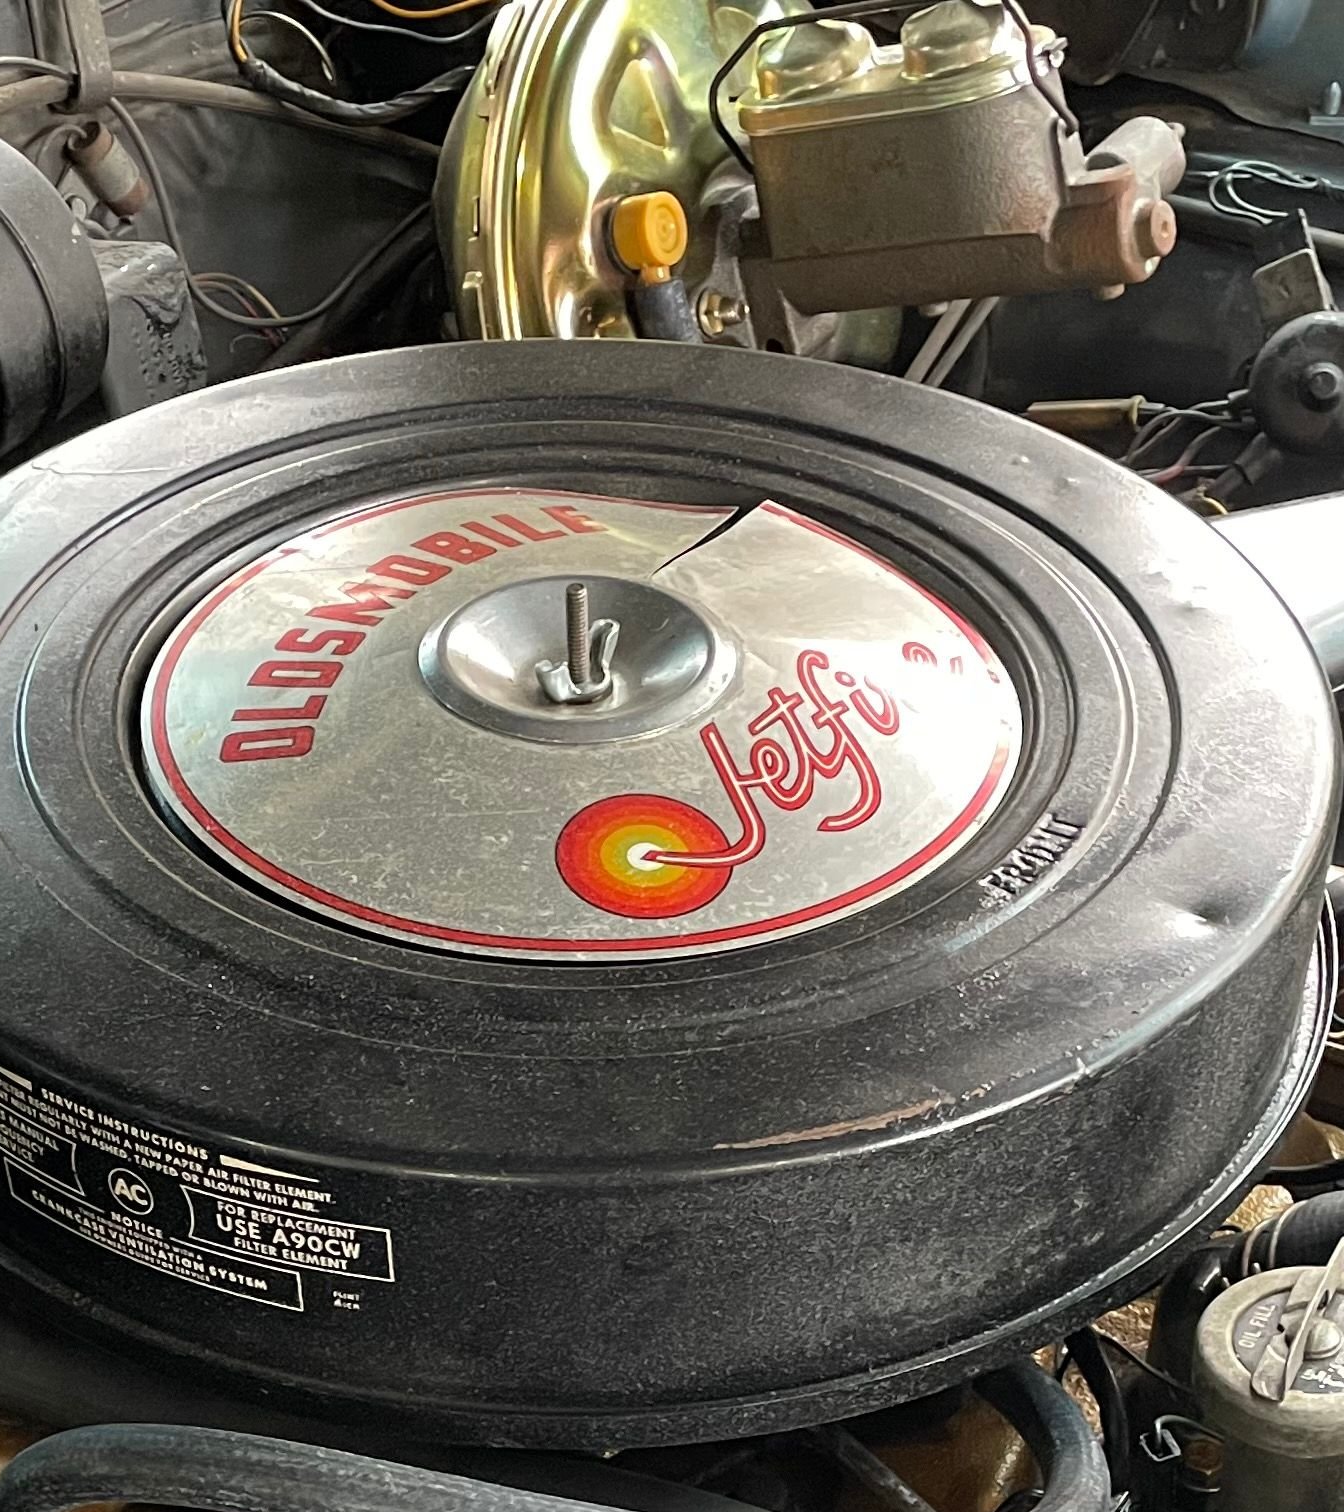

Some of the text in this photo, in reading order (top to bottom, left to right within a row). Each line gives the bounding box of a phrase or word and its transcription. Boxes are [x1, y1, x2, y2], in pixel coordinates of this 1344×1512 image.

[218, 504, 609, 765] OLDSMOBILE
[9, 1115, 60, 1151] MANUAL
[28, 1095, 87, 1131] REGULARLY
[90, 1124, 121, 1145] WITH
[123, 1138, 133, 1150] A
[134, 1142, 162, 1160] NEW
[164, 1153, 204, 1174] PAPER
[207, 1167, 229, 1181] AIR
[232, 1173, 272, 1192] FILTER
[41, 1087, 208, 1160] SERVICE INSTRUCTIONS
[38, 1112, 61, 1131] NOT
[64, 1124, 78, 1139] BE
[133, 1154, 179, 1177] TAPPED
[181, 1170, 200, 1185] OR
[203, 1177, 251, 1199] BLOWN
[253, 1190, 289, 1207] WITH
[113, 1177, 149, 1206] AC
[31, 1189, 268, 1291] CRANKCASE VENTILATION SYSTEM
[111, 1211, 164, 1239] NOTICE
[216, 1200, 357, 1241] FOR REPLACEMENT
[216, 1213, 361, 1260] USE A90CW
[233, 1237, 348, 1270] FILTER ELEMENT
[1237, 1303, 1277, 1350] OIL FILL
